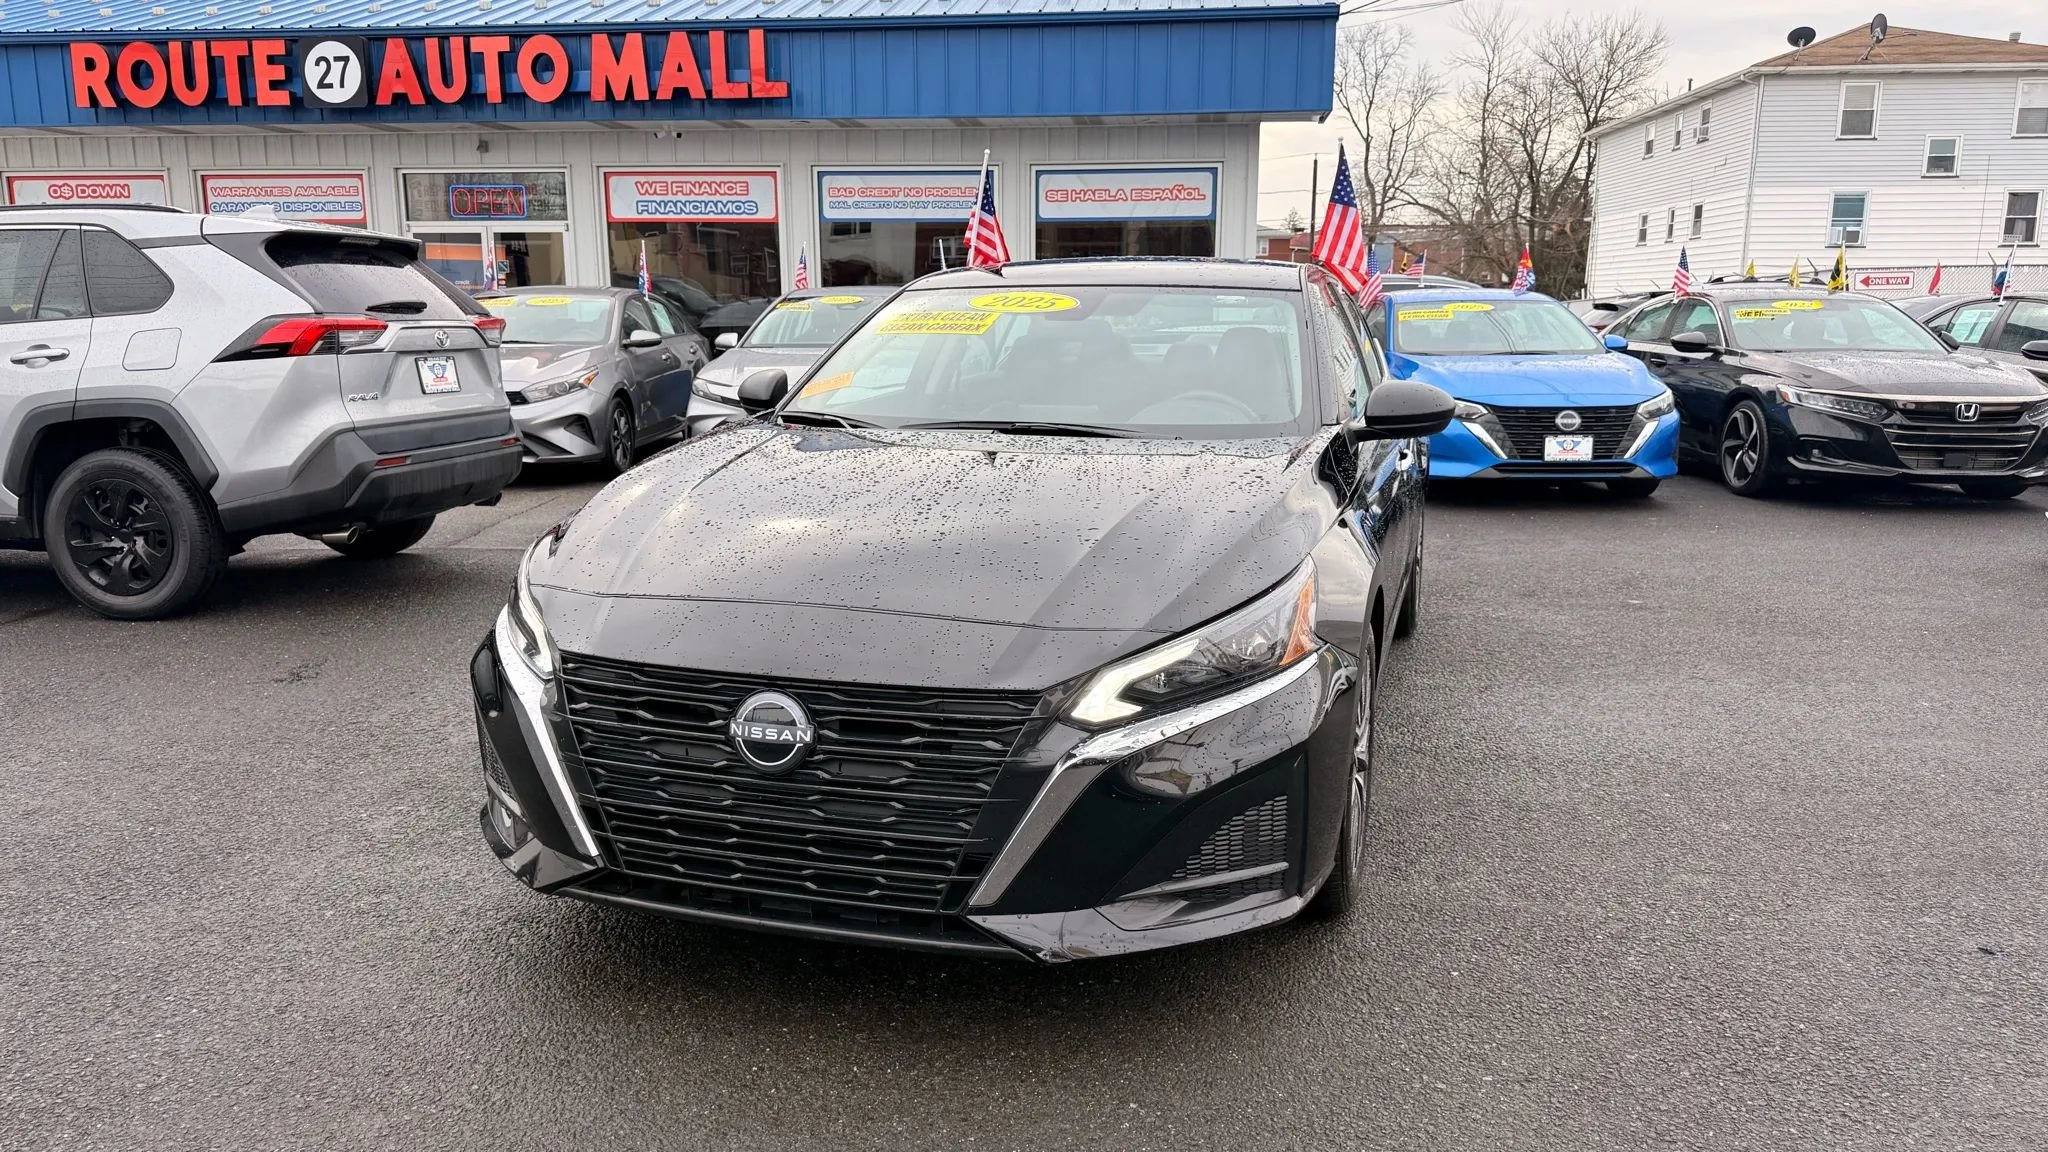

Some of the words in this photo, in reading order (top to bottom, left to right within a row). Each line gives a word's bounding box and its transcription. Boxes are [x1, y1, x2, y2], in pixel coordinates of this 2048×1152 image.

[69, 39, 291, 108] ROUTE
[314, 55, 350, 89] 27
[376, 34, 569, 105] AUTO
[590, 29, 788, 101] MALL
[49, 183, 74, 200] 0$
[76, 184, 130, 198] DOWN
[211, 186, 292, 197] WARRANTIES
[294, 185, 359, 196] AVAILABLE
[635, 181, 668, 195] WE
[669, 181, 748, 195] FINANCE
[829, 187, 856, 198] BAD
[857, 187, 901, 198] CREDIT
[904, 187, 923, 198] NO
[1045, 189, 1070, 202] SE
[1071, 189, 1128, 202] HABLA
[1130, 184, 1207, 201] ESPAÑOL
[210, 202, 281, 213] GARANS
[283, 201, 362, 212] DISPONIBLES
[452, 188, 523, 215] OPEN
[636, 200, 759, 215] FINANCIAMOS
[829, 201, 851, 209] MAL
[852, 201, 892, 209] CREDITO
[894, 201, 908, 209] NO
[910, 201, 930, 209] HAY
[1868, 277, 1887, 285] ONE
[1888, 276, 1909, 285] WAY
[984, 295, 1058, 309] 2025
[941, 312, 992, 322] CLEAN
[926, 322, 989, 332] CARFAX
[348, 392, 378, 402] RAV4
[730, 723, 811, 742] NISSAN
